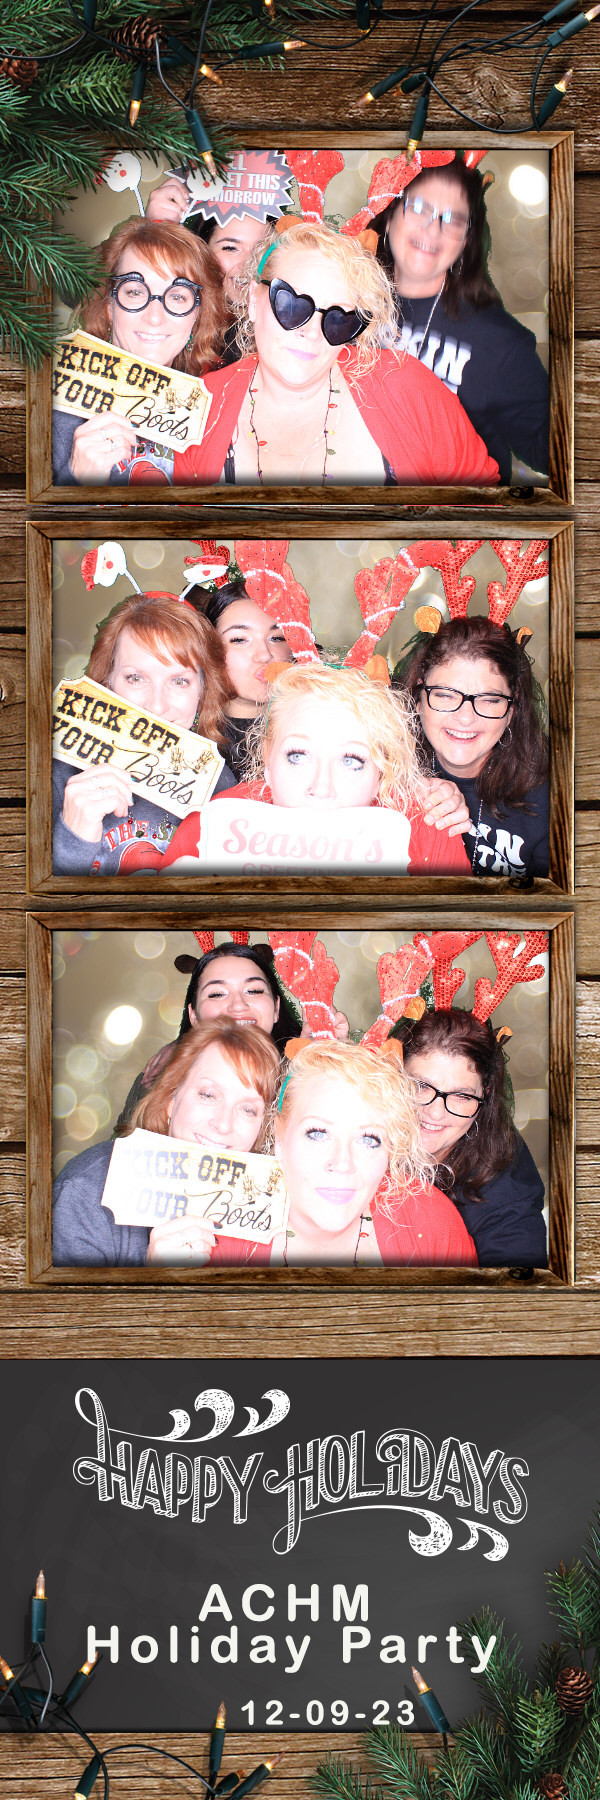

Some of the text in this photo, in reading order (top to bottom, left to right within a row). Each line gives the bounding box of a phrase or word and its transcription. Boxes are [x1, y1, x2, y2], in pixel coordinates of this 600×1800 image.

[209, 189, 276, 206] MORROW
[247, 173, 281, 190] THIS
[57, 344, 171, 396] KICK OFF
[53, 370, 189, 441] YOUR Boots
[56, 688, 180, 754] KICK OFF
[52, 715, 197, 805] YOUR Boots
[104, 821, 149, 852] THE
[223, 818, 383, 864] Season's
[198, 1154, 247, 1187] OFF
[136, 1187, 272, 1232] OUR Boots
